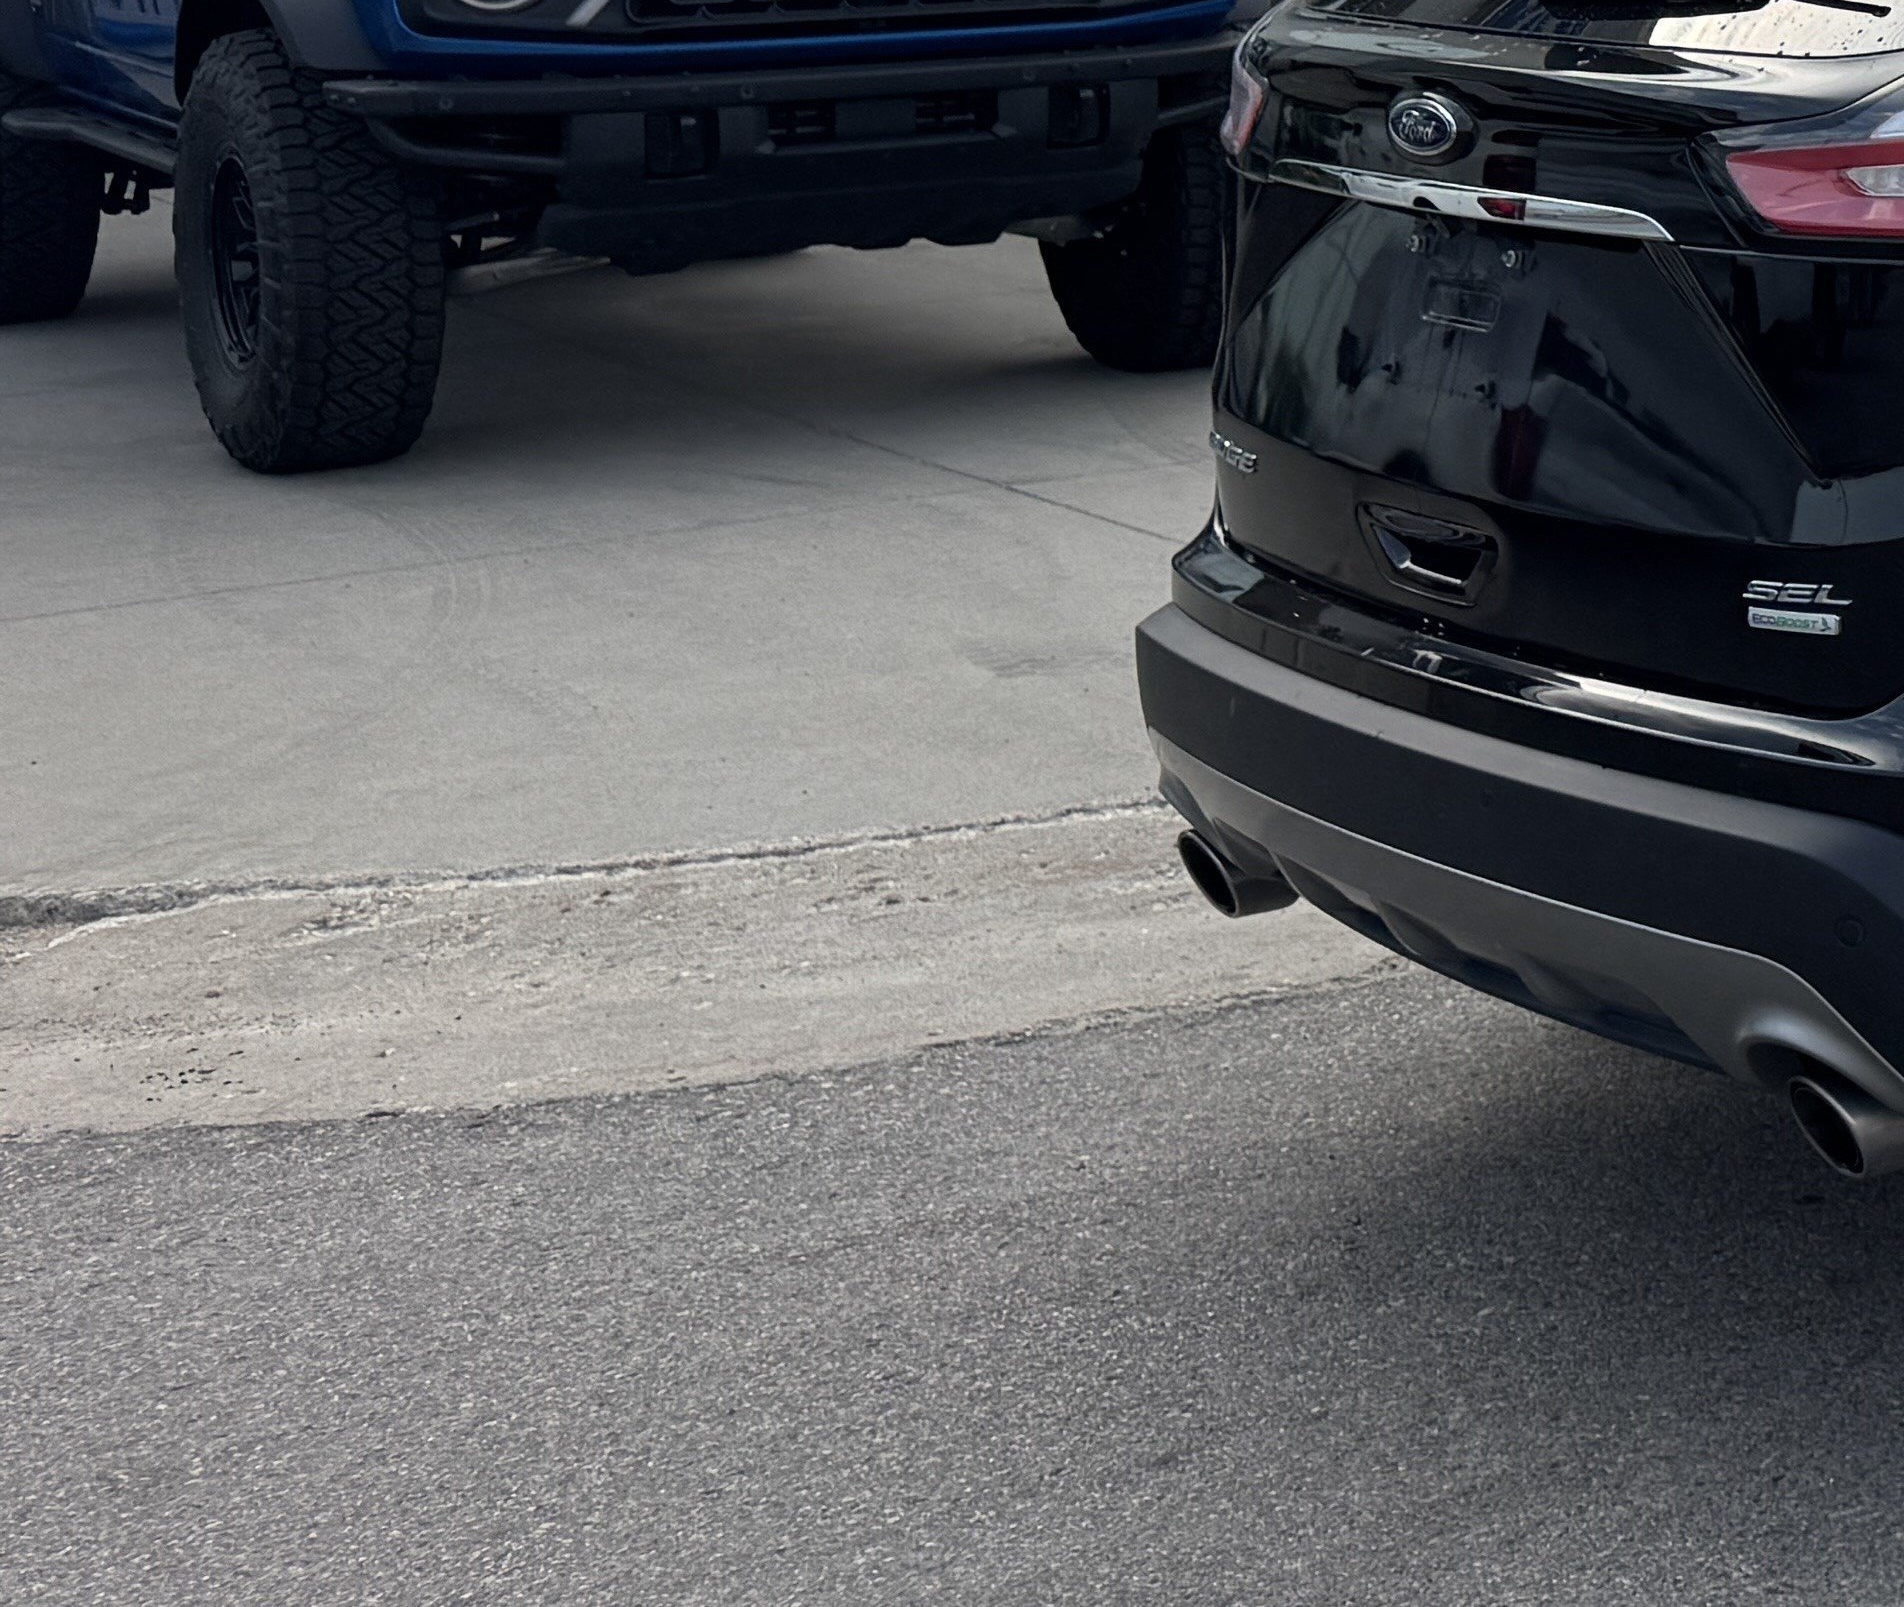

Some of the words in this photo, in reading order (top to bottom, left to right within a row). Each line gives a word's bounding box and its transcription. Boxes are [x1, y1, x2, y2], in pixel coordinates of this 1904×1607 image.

[1398, 109, 1437, 144] Ford
[1742, 580, 1853, 606] SEL
[1751, 613, 1820, 629] ECOBOOST
